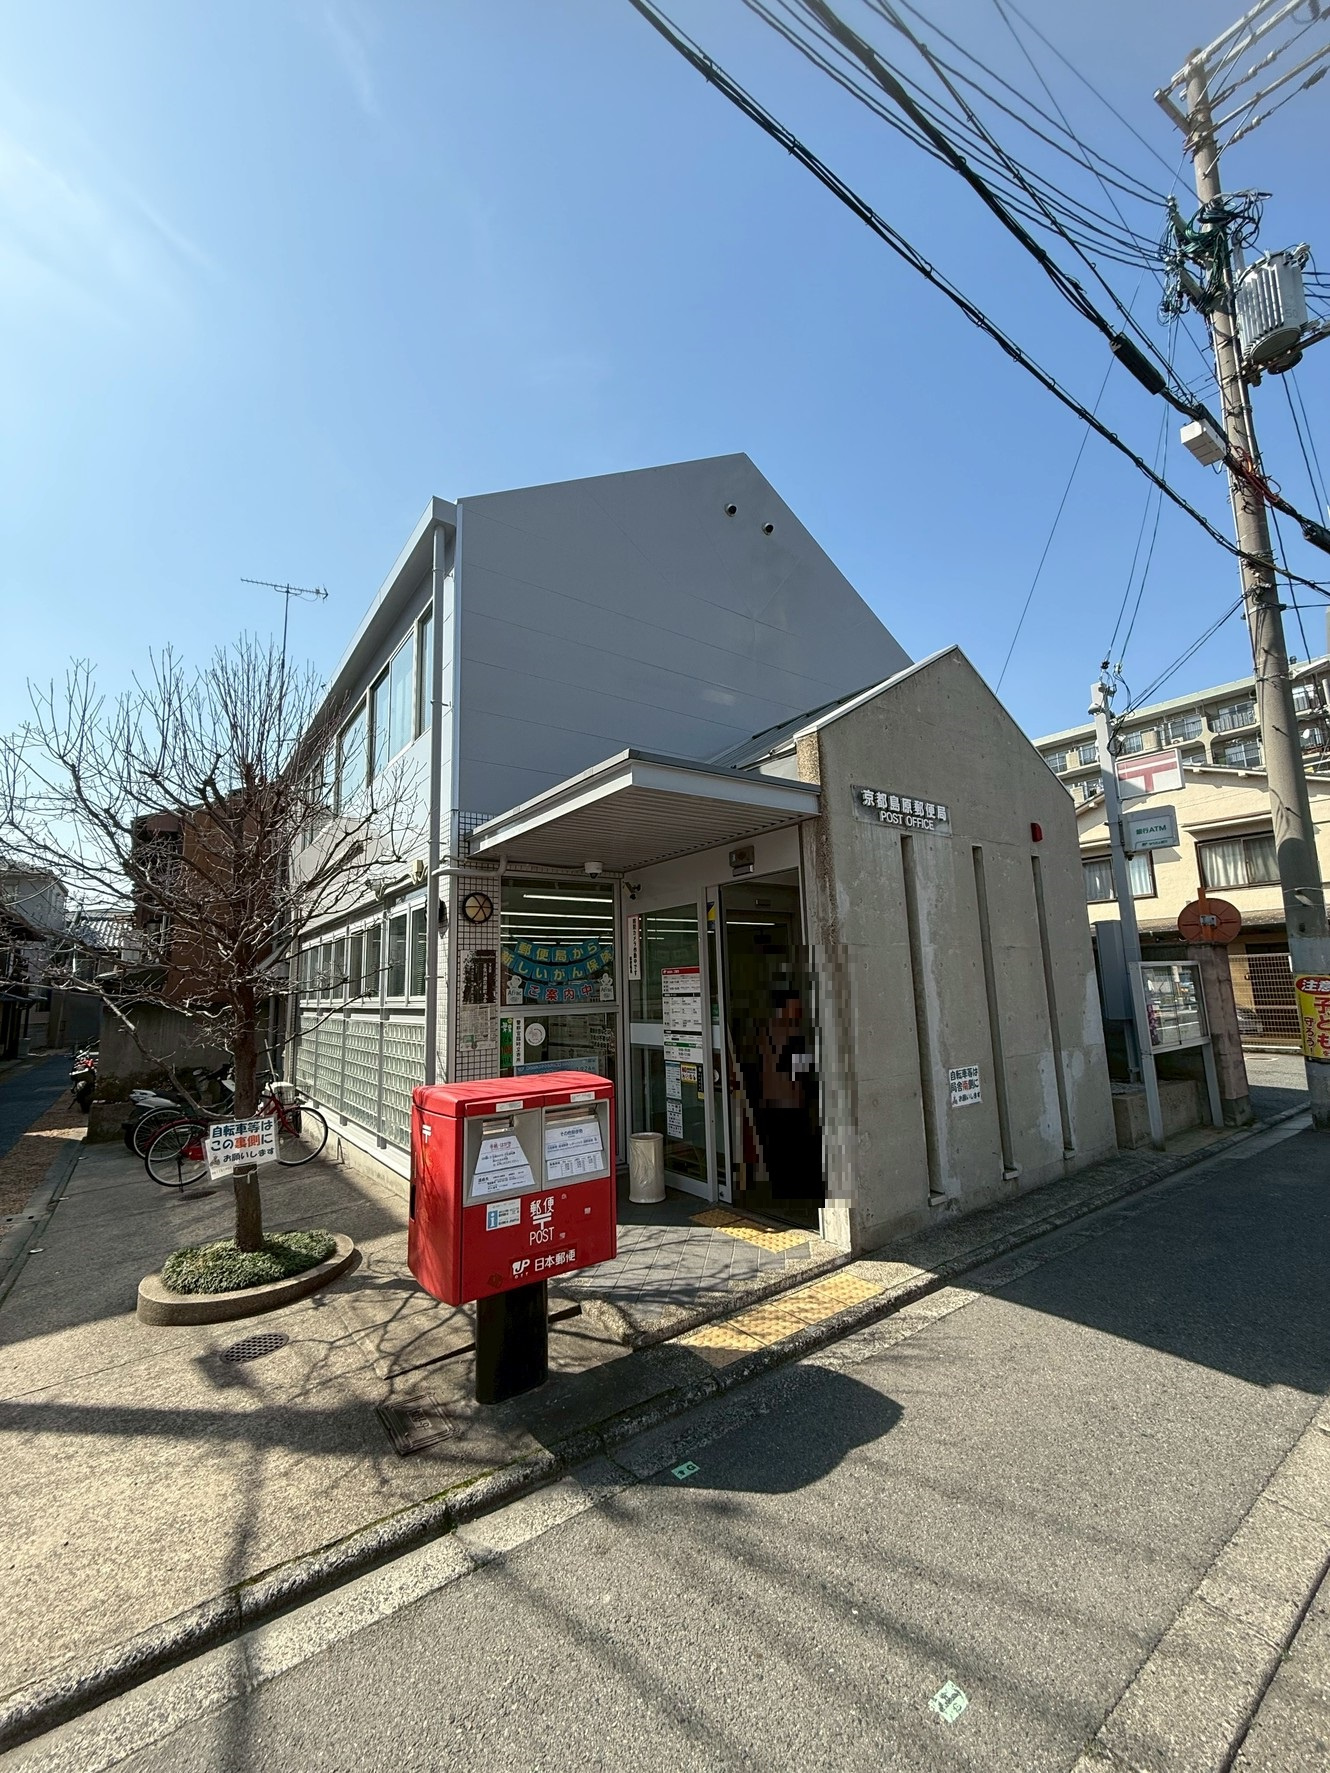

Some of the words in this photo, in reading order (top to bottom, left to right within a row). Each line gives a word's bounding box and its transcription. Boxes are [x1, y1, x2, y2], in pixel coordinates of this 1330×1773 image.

[861, 789, 947, 821] 京都島原郵便局
[880, 810, 903, 825] POST
[906, 816, 935, 830] OFFICE
[518, 942, 598, 961] 郵便局から
[502, 949, 614, 980] 新しいがん保険
[528, 984, 593, 1002] ご案内中
[1301, 979, 1330, 991] 注意
[212, 1120, 273, 1138] 自転車等は
[211, 1133, 273, 1151] この裏側に
[223, 1148, 274, 1162] お願いします
[530, 1196, 554, 1217] 郵便
[529, 1227, 555, 1246] POST
[535, 1249, 576, 1272] 日本郵便
